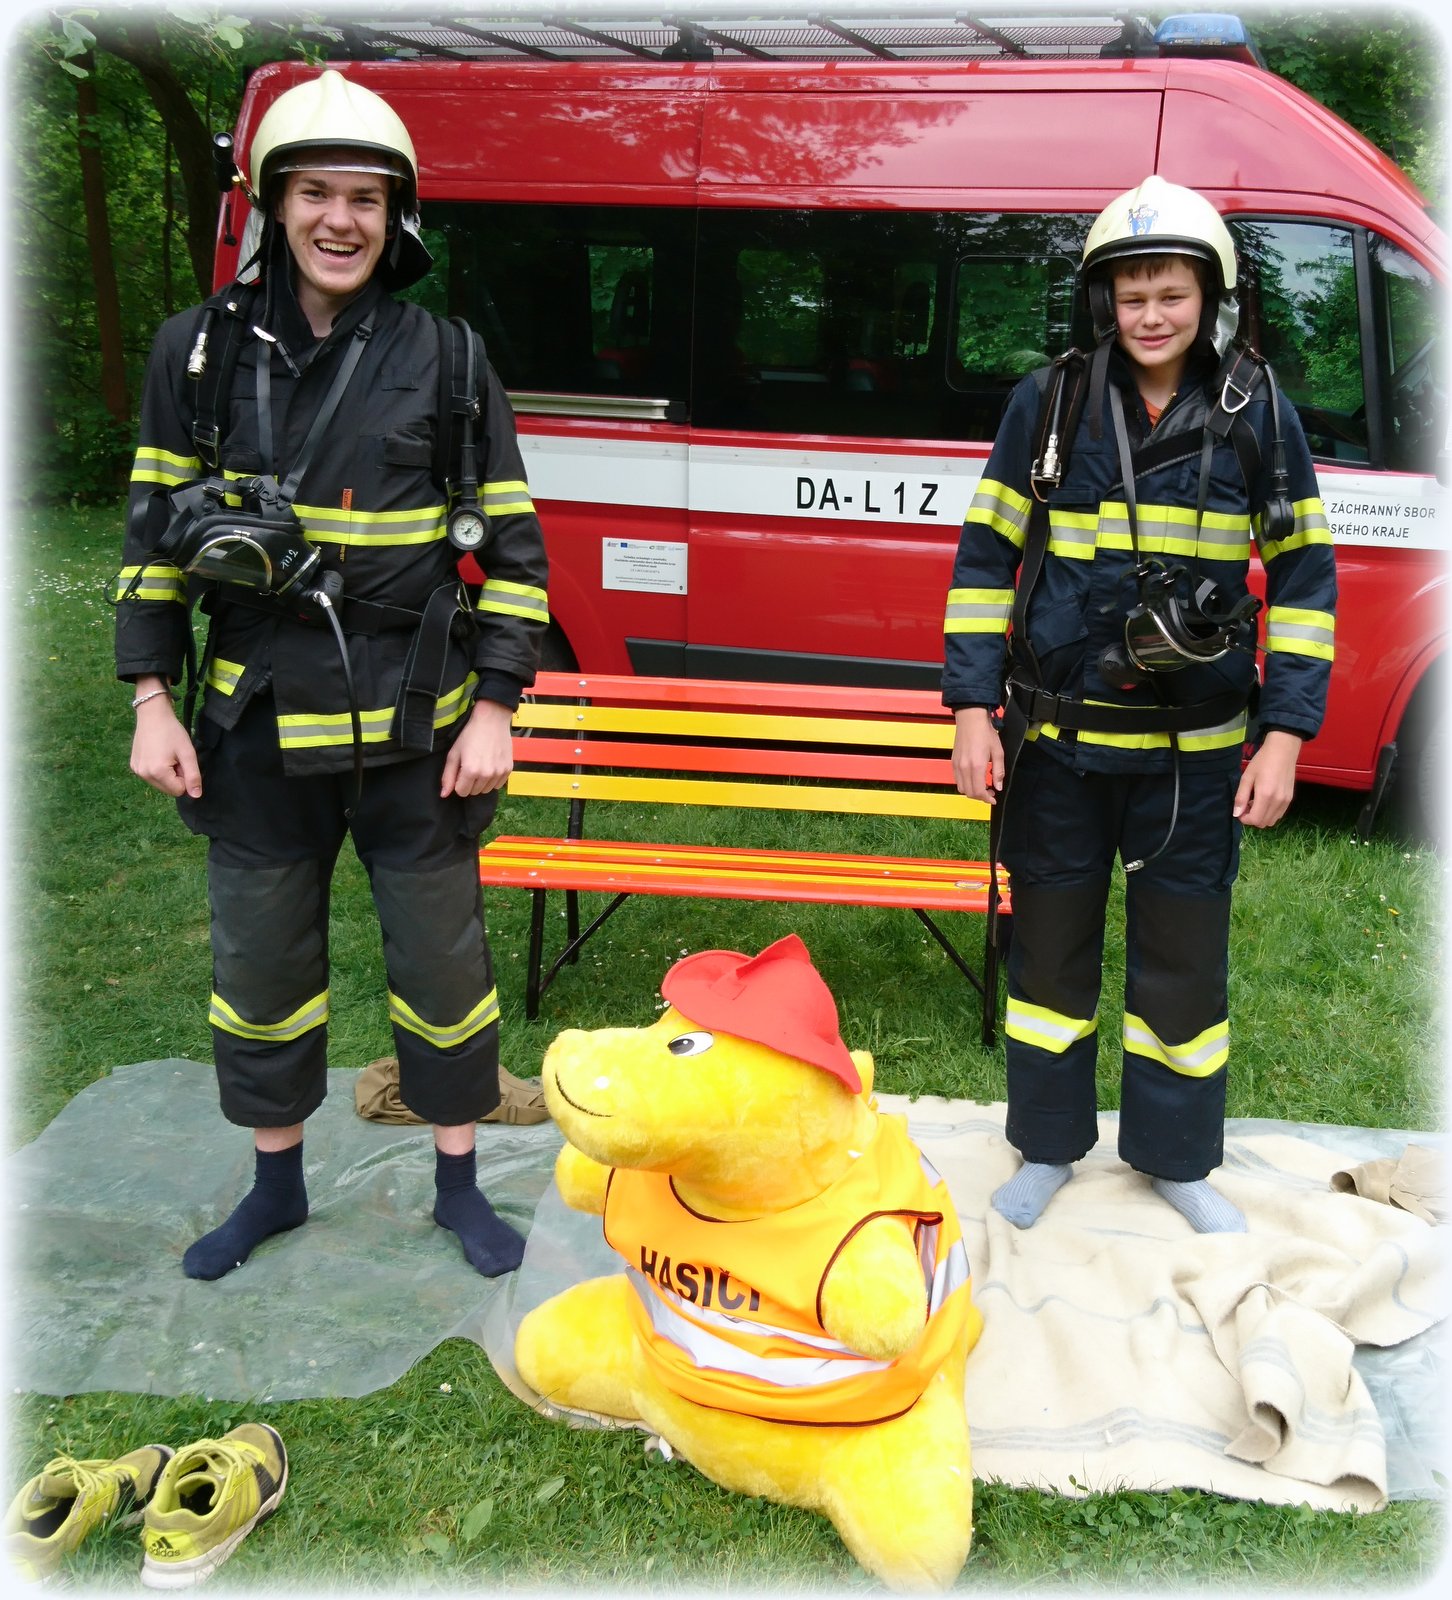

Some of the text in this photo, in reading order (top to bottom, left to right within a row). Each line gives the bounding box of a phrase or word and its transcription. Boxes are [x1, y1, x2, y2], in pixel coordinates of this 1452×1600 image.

[1330, 500, 1402, 517] ZÁCHRANNÝ
[1403, 506, 1436, 519] SBOR
[1328, 522, 1410, 539] SKÉHO KRAJE
[149, 1546, 181, 1558] adidas
